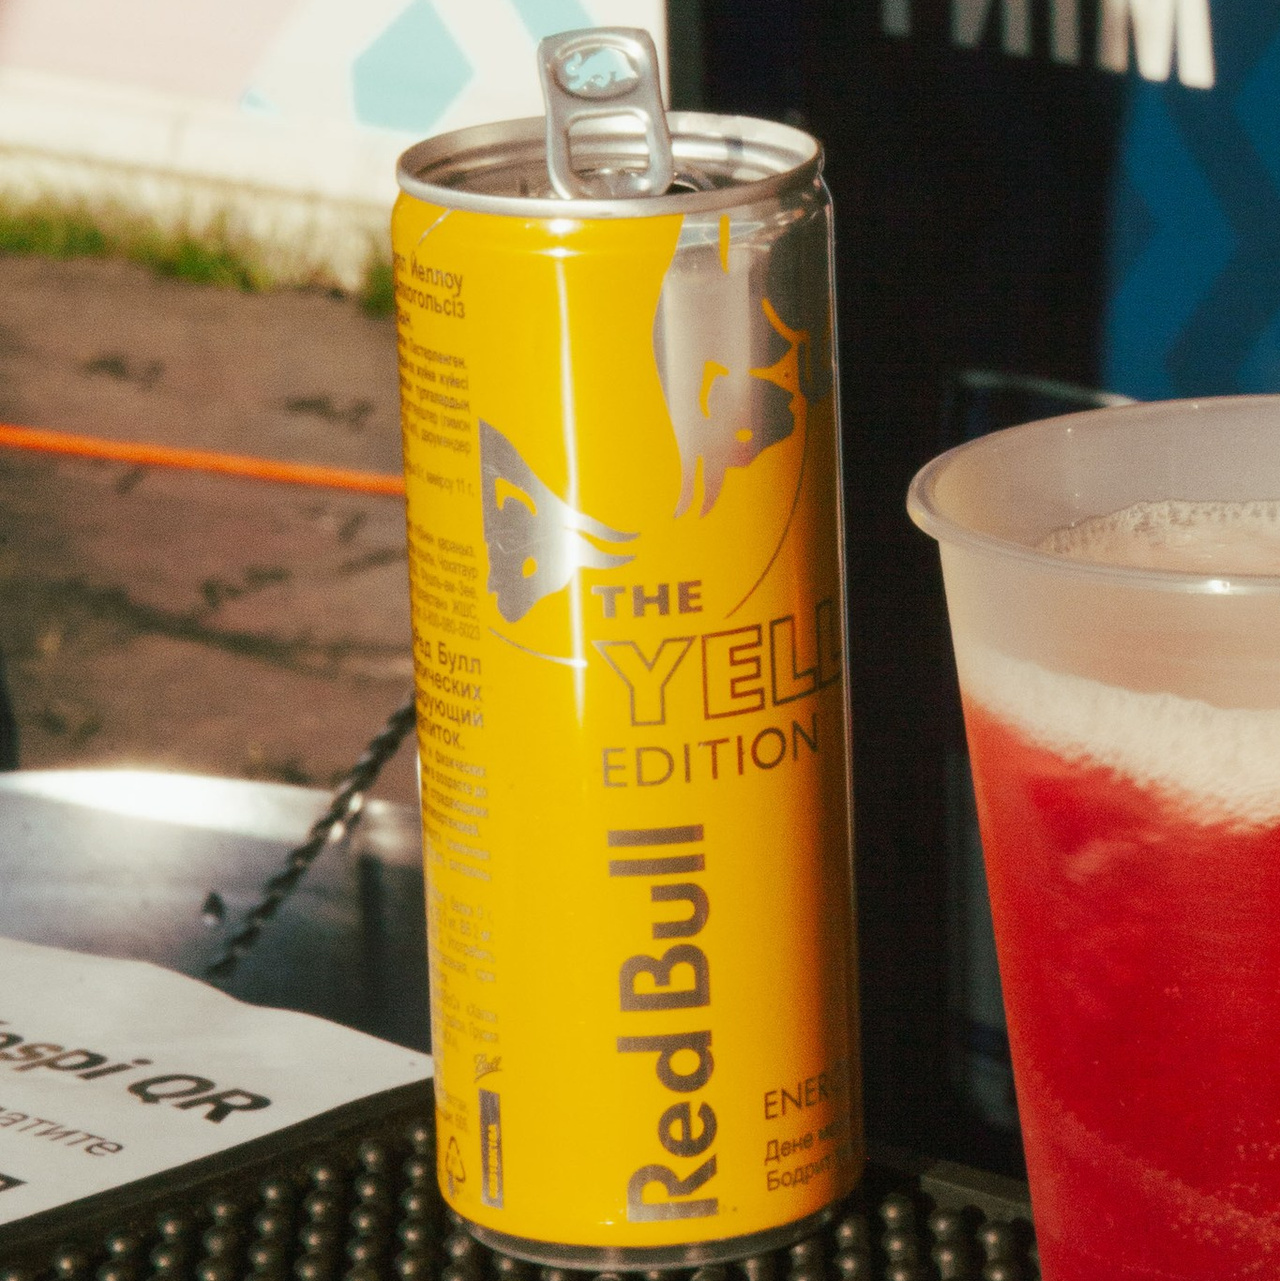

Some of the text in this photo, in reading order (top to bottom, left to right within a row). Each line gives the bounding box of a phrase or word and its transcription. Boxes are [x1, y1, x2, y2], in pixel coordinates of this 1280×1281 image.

[411, 251, 464, 298] Йеллоу
[591, 580, 703, 619] THE
[437, 640, 482, 676] Булл
[602, 712, 819, 788] EDITION
[607, 824, 720, 1222] Red Bull
[127, 1073, 272, 1124] QR
[0, 1107, 124, 1156] атите
[764, 1131, 815, 1166] Дене
